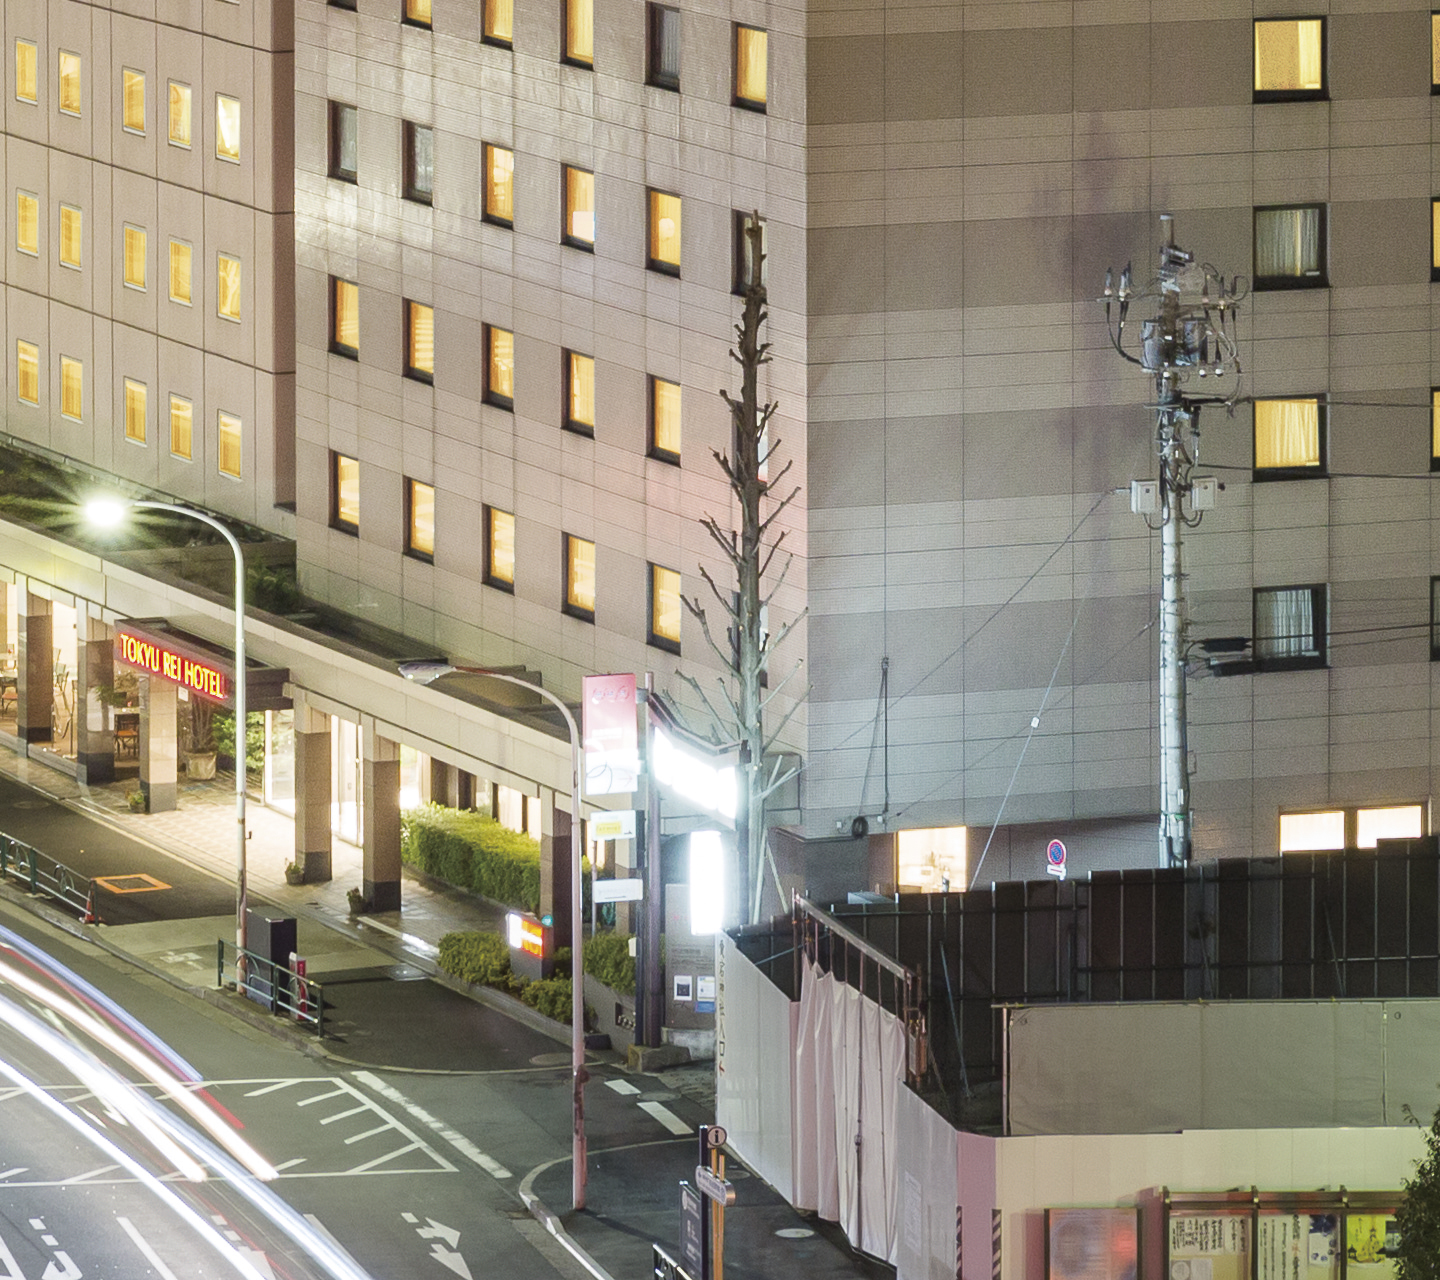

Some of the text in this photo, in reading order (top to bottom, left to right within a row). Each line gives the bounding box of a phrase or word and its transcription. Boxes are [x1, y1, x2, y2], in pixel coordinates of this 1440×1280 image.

[120, 633, 225, 698] TOKYU REI HOTEL
